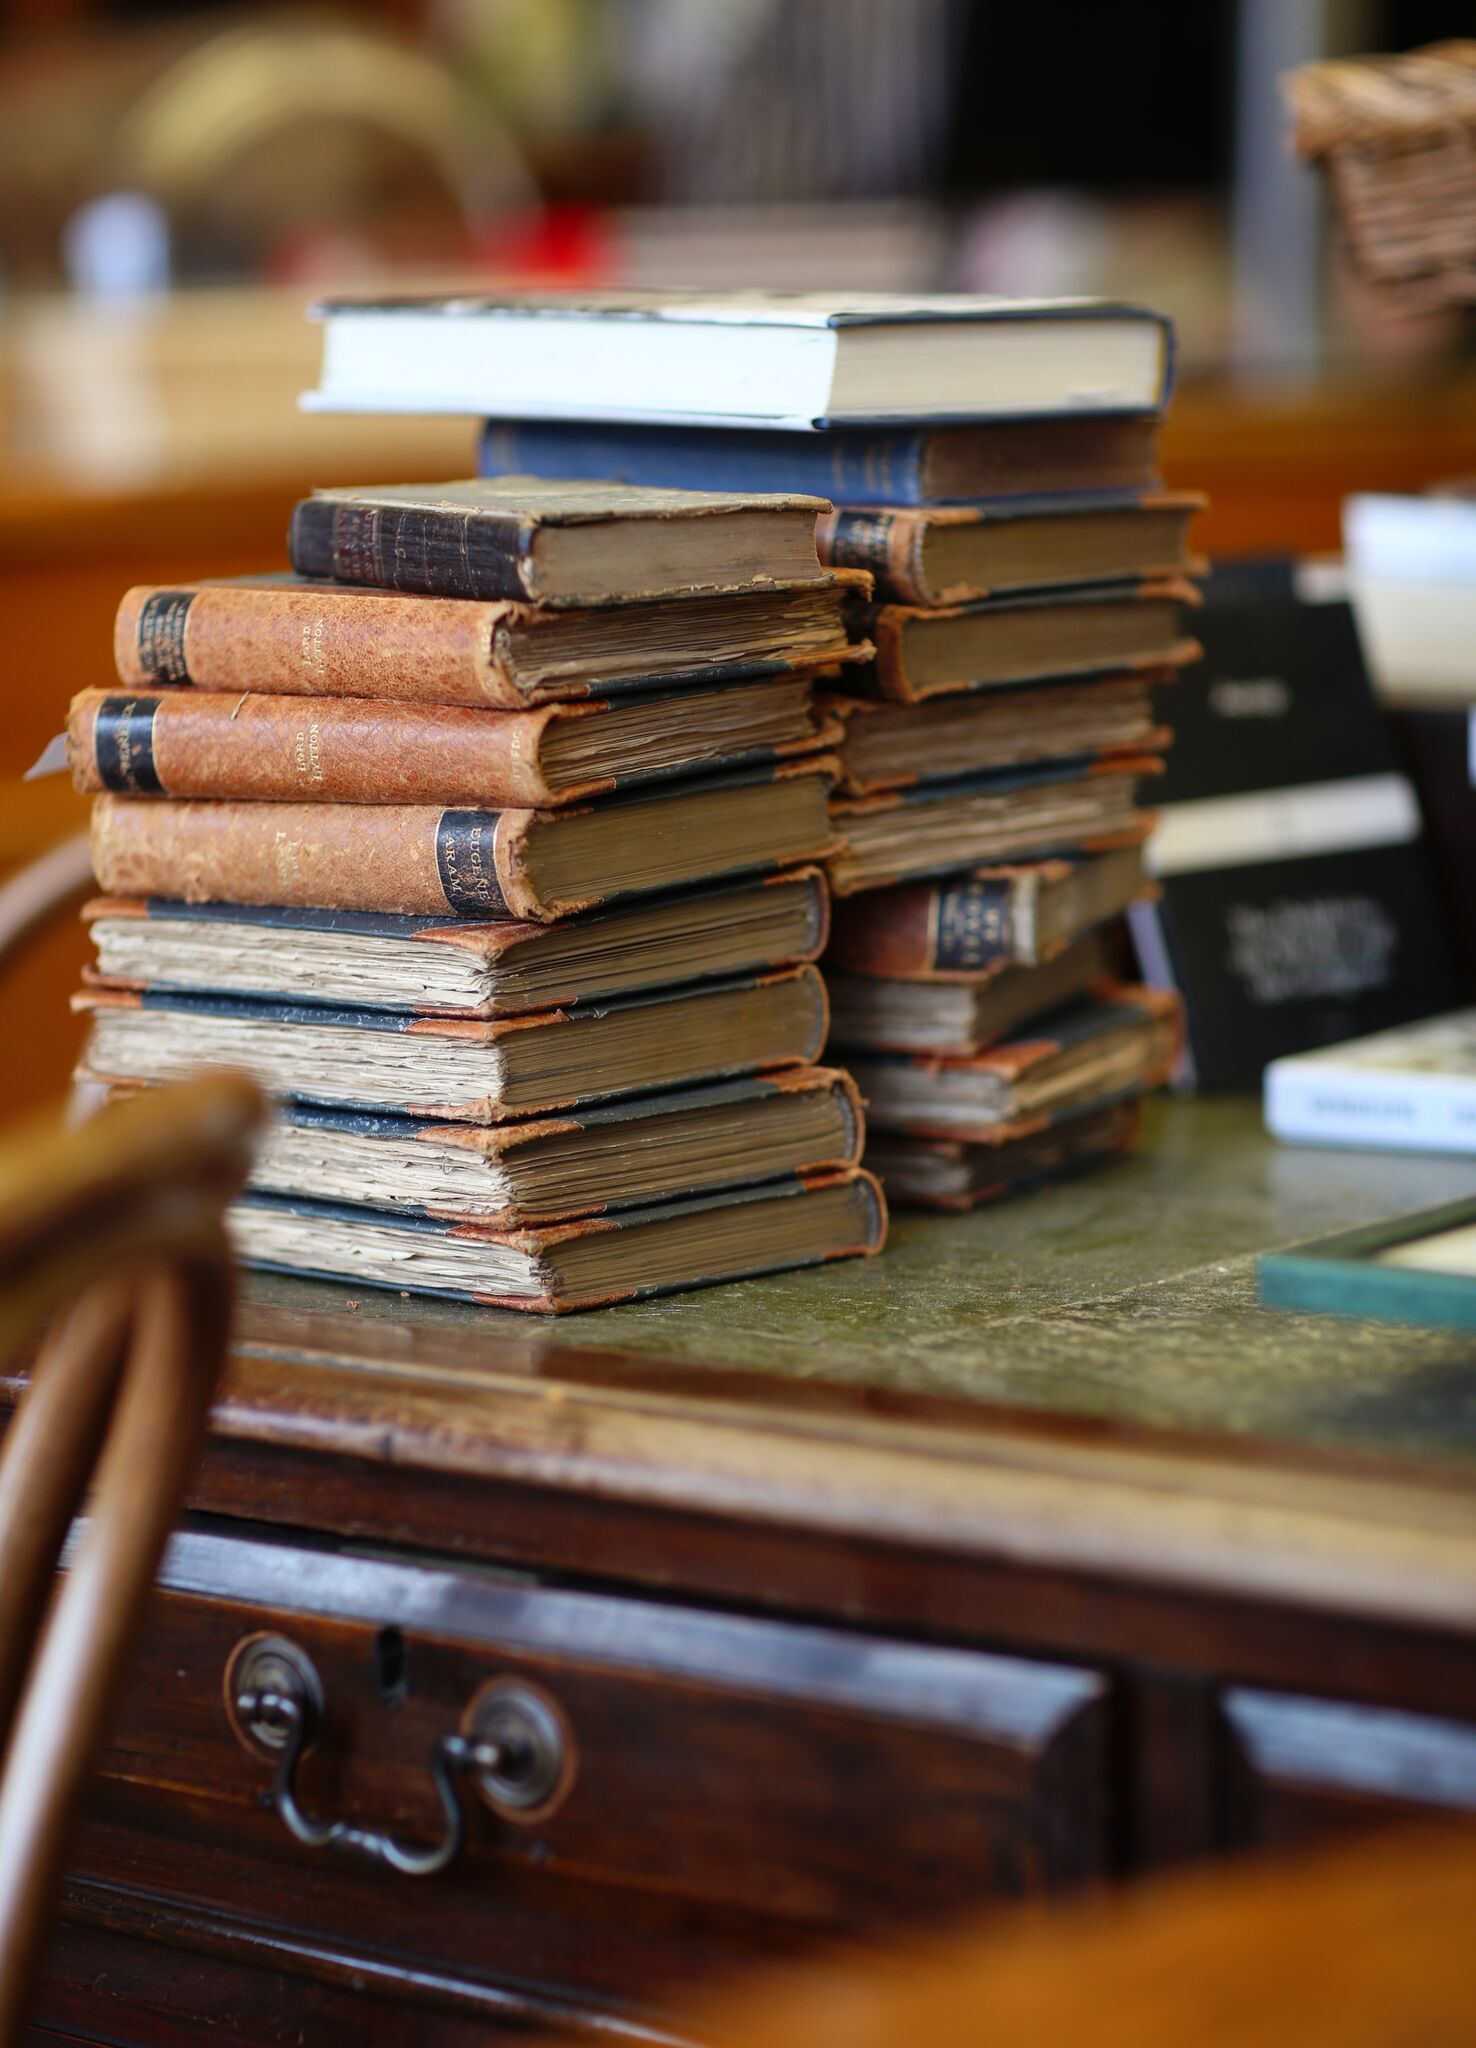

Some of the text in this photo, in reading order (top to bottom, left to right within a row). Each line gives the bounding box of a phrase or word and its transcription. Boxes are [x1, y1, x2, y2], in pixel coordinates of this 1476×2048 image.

[302, 625, 312, 666] LORD
[296, 731, 307, 772] LORD
[309, 724, 323, 781] LYTTON
[511, 721, 526, 794] UTLEDG
[445, 834, 463, 893] ARAM
[470, 827, 491, 901] EUGENE
